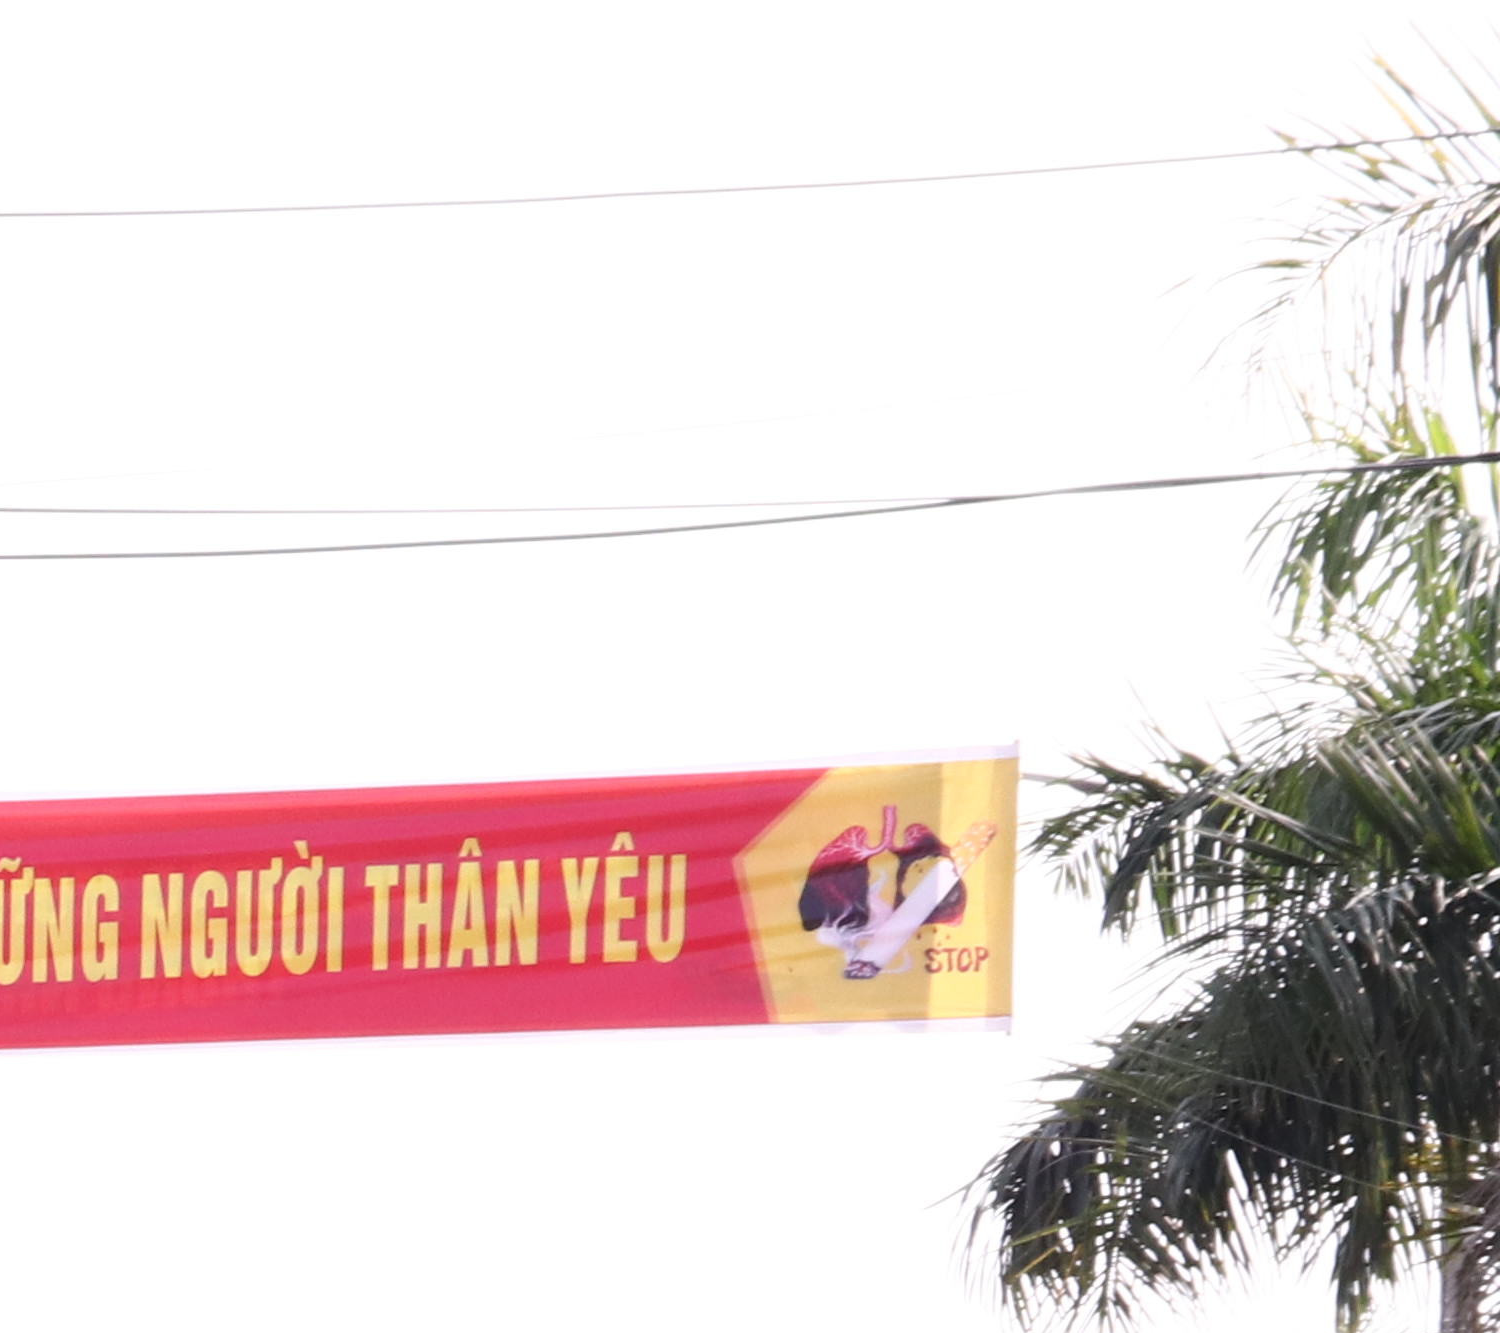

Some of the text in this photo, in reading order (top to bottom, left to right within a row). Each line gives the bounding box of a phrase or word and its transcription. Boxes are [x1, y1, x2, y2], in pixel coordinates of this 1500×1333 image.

[140, 839, 341, 980] NGƯỜI
[365, 837, 539, 972] THÂN
[560, 831, 688, 964] YÊU
[924, 944, 990, 974] STOP
